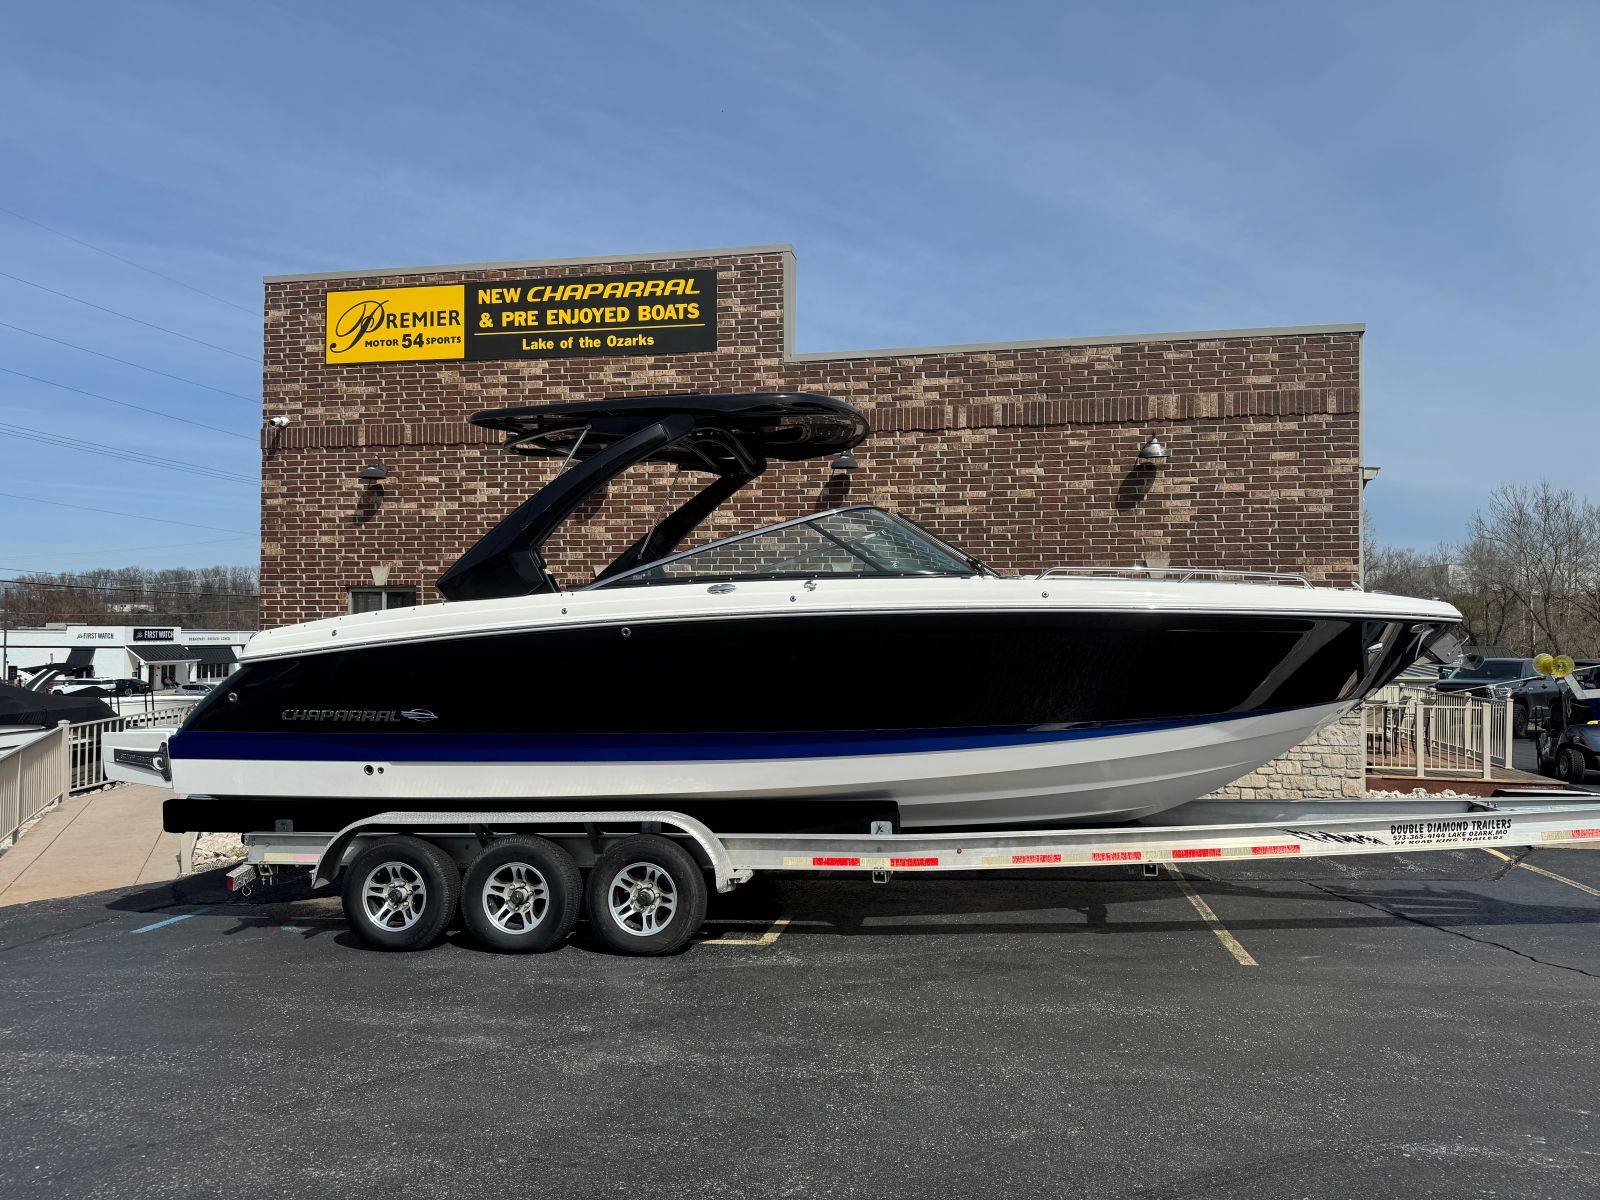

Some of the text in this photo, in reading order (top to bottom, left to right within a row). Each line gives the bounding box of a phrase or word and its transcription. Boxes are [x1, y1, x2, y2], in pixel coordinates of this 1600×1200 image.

[478, 278, 700, 304] NEW CHAPARRAL
[478, 303, 700, 328] & PRE ENJOYED BOATS
[330, 300, 461, 354] PREMIER
[365, 333, 461, 348] MOTOR 54 SPORTS
[522, 334, 655, 350] Lake of the Ozarks
[83, 632, 114, 640] FIRST WATCH
[144, 629, 174, 639] FIRST WATCH
[281, 709, 400, 722] CHAPARRAL
[1390, 819, 1512, 834] DOUBLE DIAMOND TRAILERS
